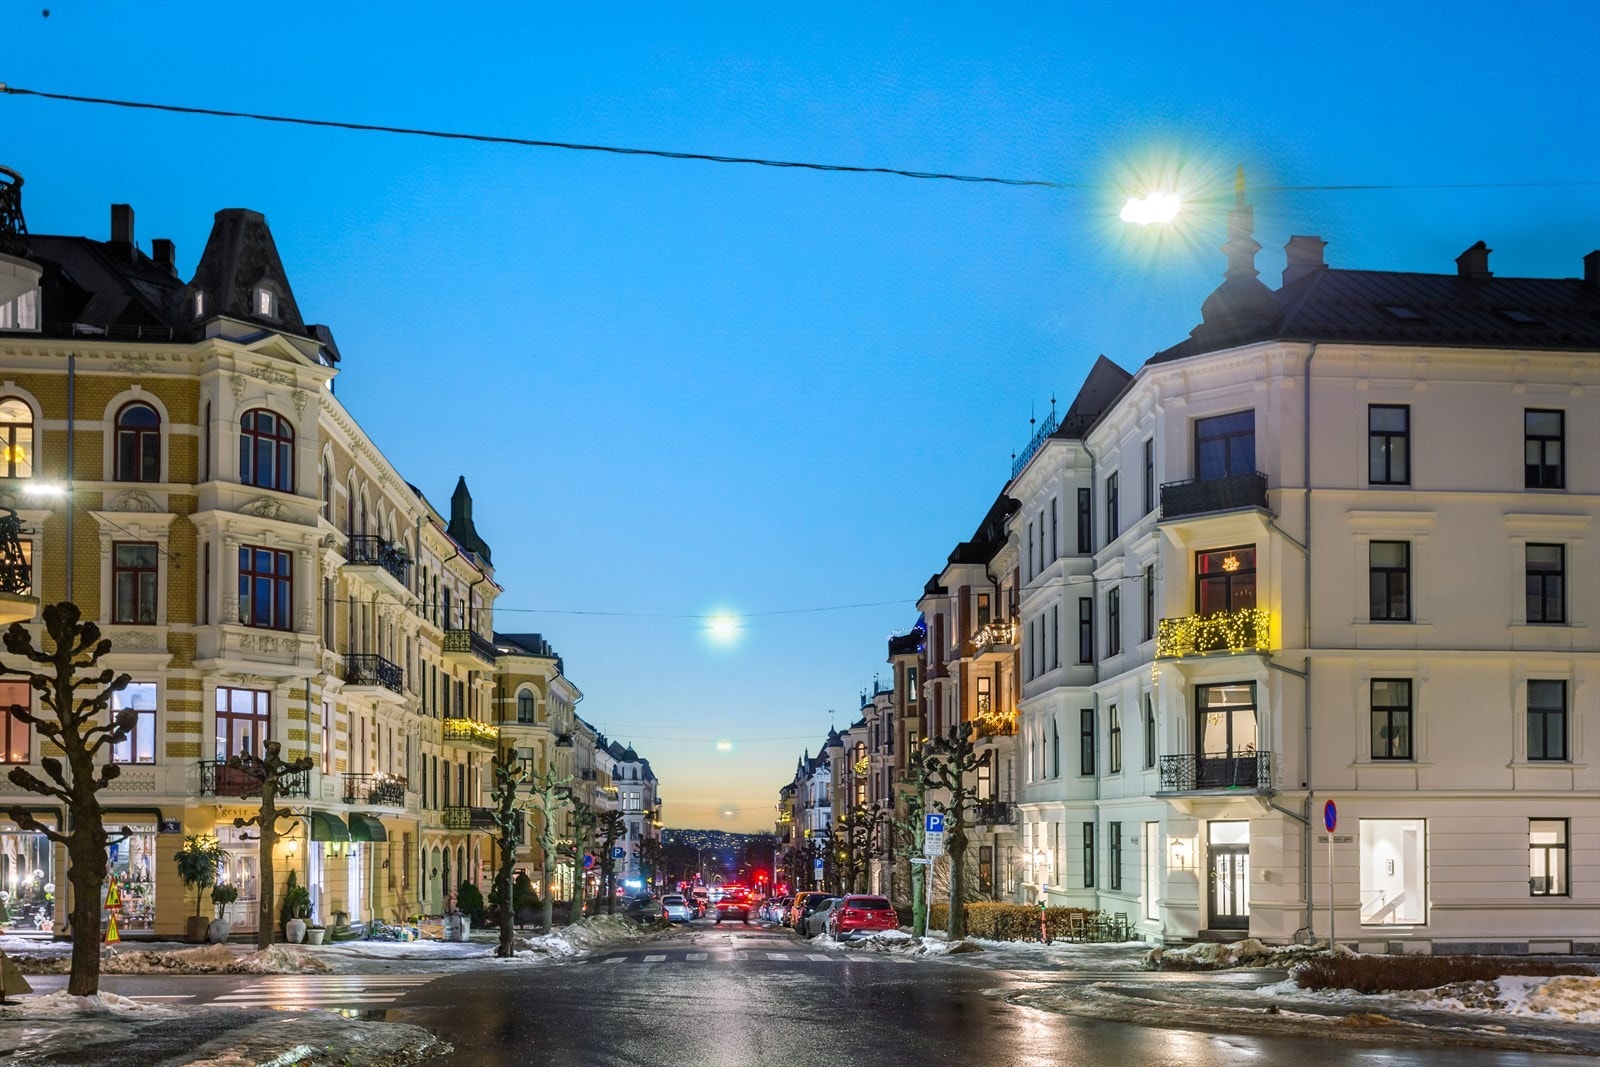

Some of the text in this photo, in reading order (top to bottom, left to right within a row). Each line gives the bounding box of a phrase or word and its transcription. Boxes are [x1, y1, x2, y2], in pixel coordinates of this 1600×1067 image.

[222, 808, 248, 817] gevir
[930, 817, 940, 830] P
[615, 849, 621, 857] P
